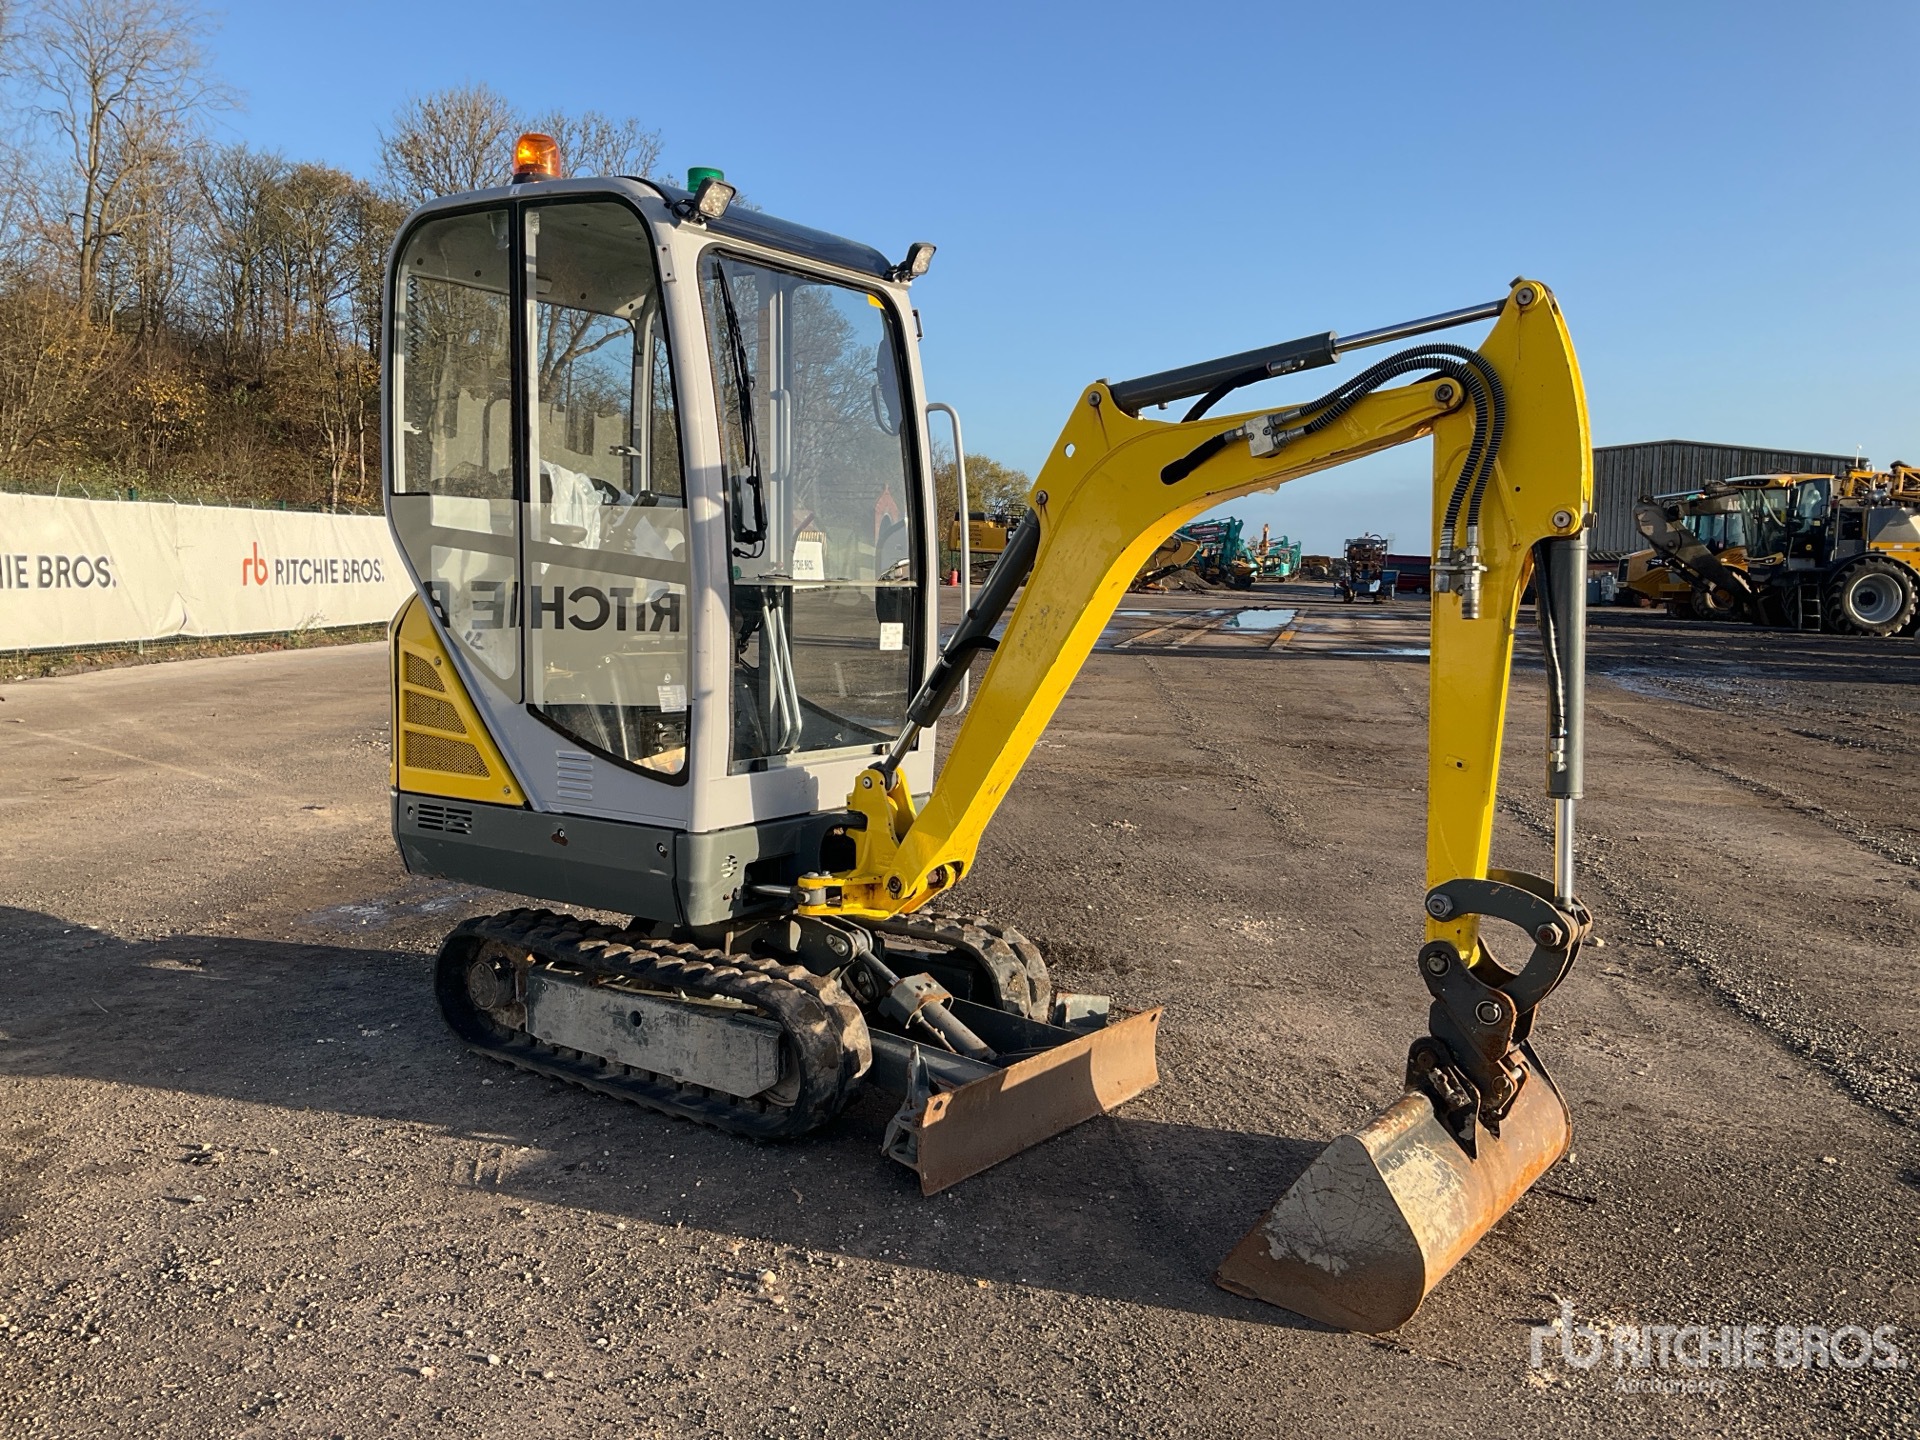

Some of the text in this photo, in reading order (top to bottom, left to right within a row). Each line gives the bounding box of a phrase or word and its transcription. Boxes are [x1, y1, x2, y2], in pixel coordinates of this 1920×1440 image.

[0, 554, 117, 589] IE BROS.
[242, 541, 385, 586] rb RITCHIE BROS.
